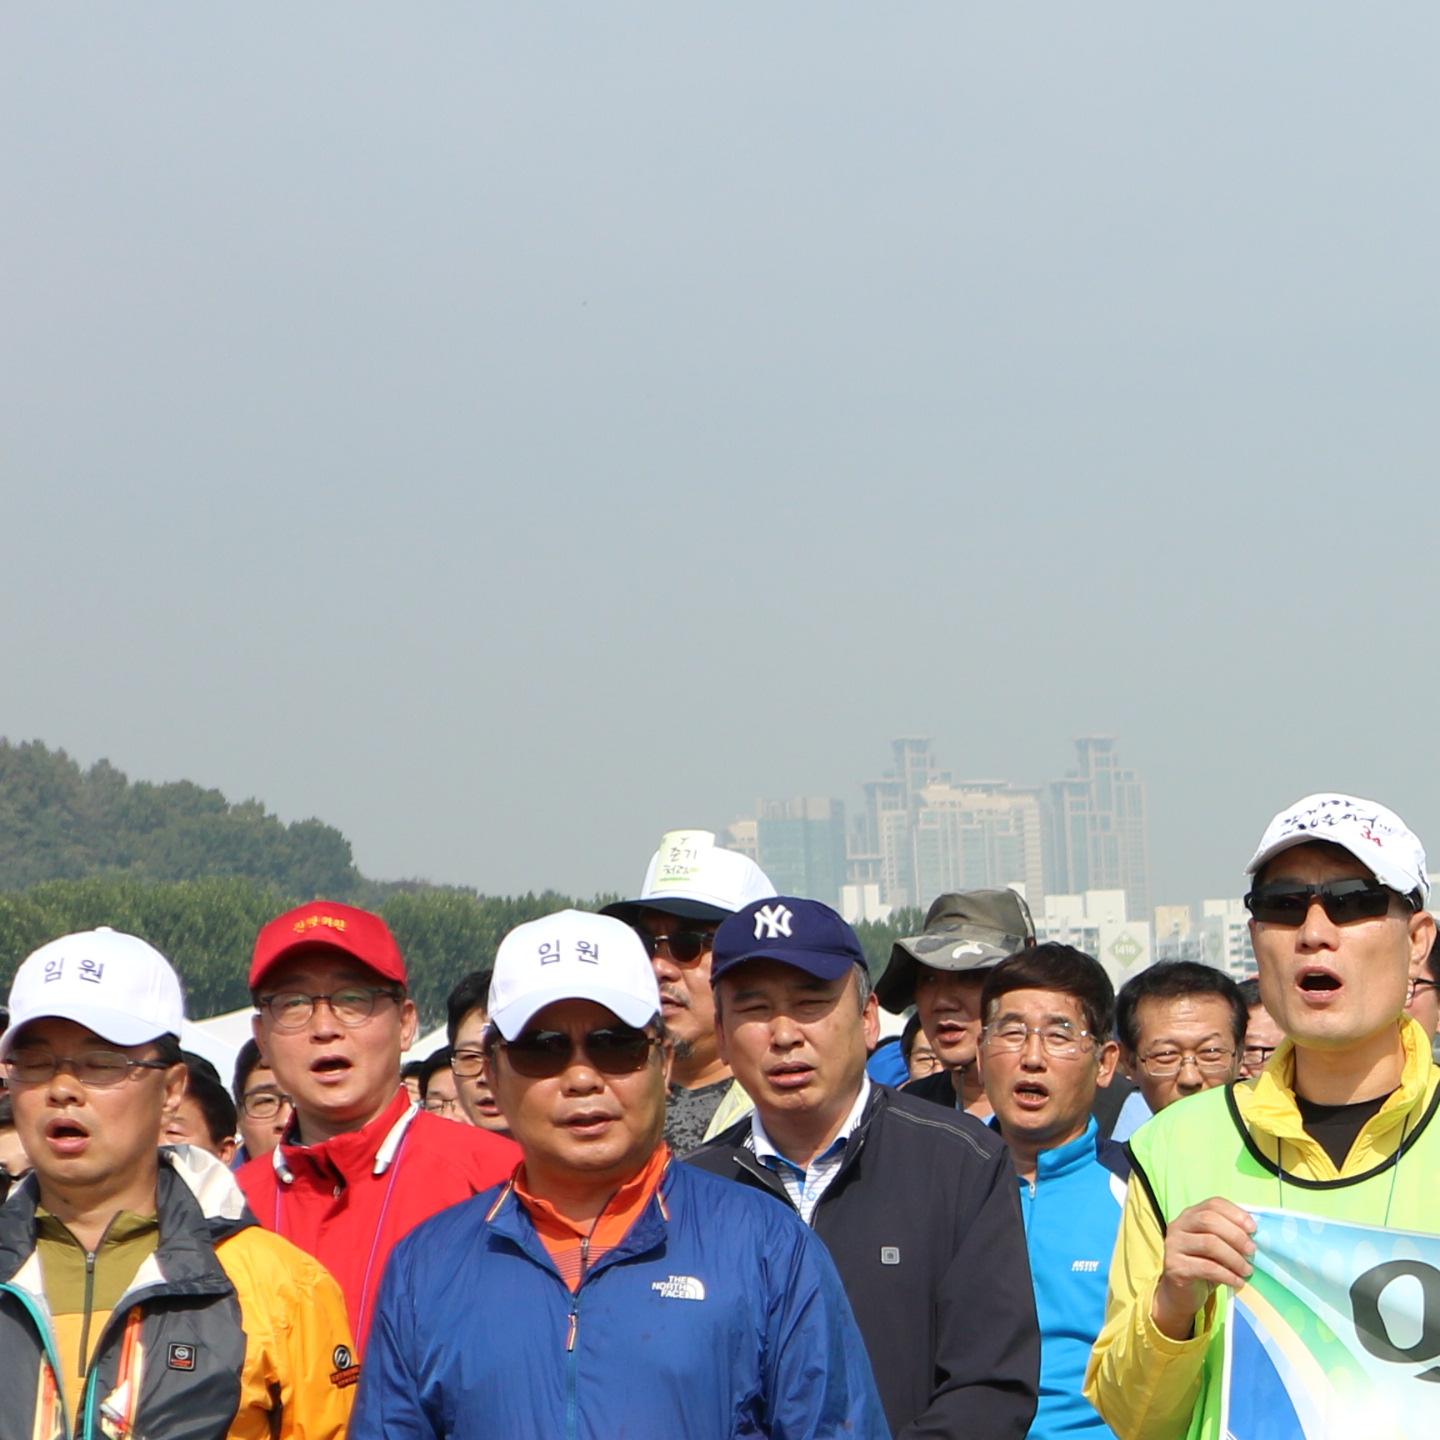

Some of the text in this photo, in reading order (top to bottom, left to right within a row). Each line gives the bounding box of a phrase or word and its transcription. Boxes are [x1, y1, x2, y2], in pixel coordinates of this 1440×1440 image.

[1360, 825, 1382, 848] 34
[754, 904, 793, 940] NY
[538, 939, 599, 966] 임원
[44, 956, 104, 984] 임원
[652, 1282, 686, 1291] NORTH
[668, 1275, 687, 1283] THE
[661, 1290, 686, 1299] FACE
